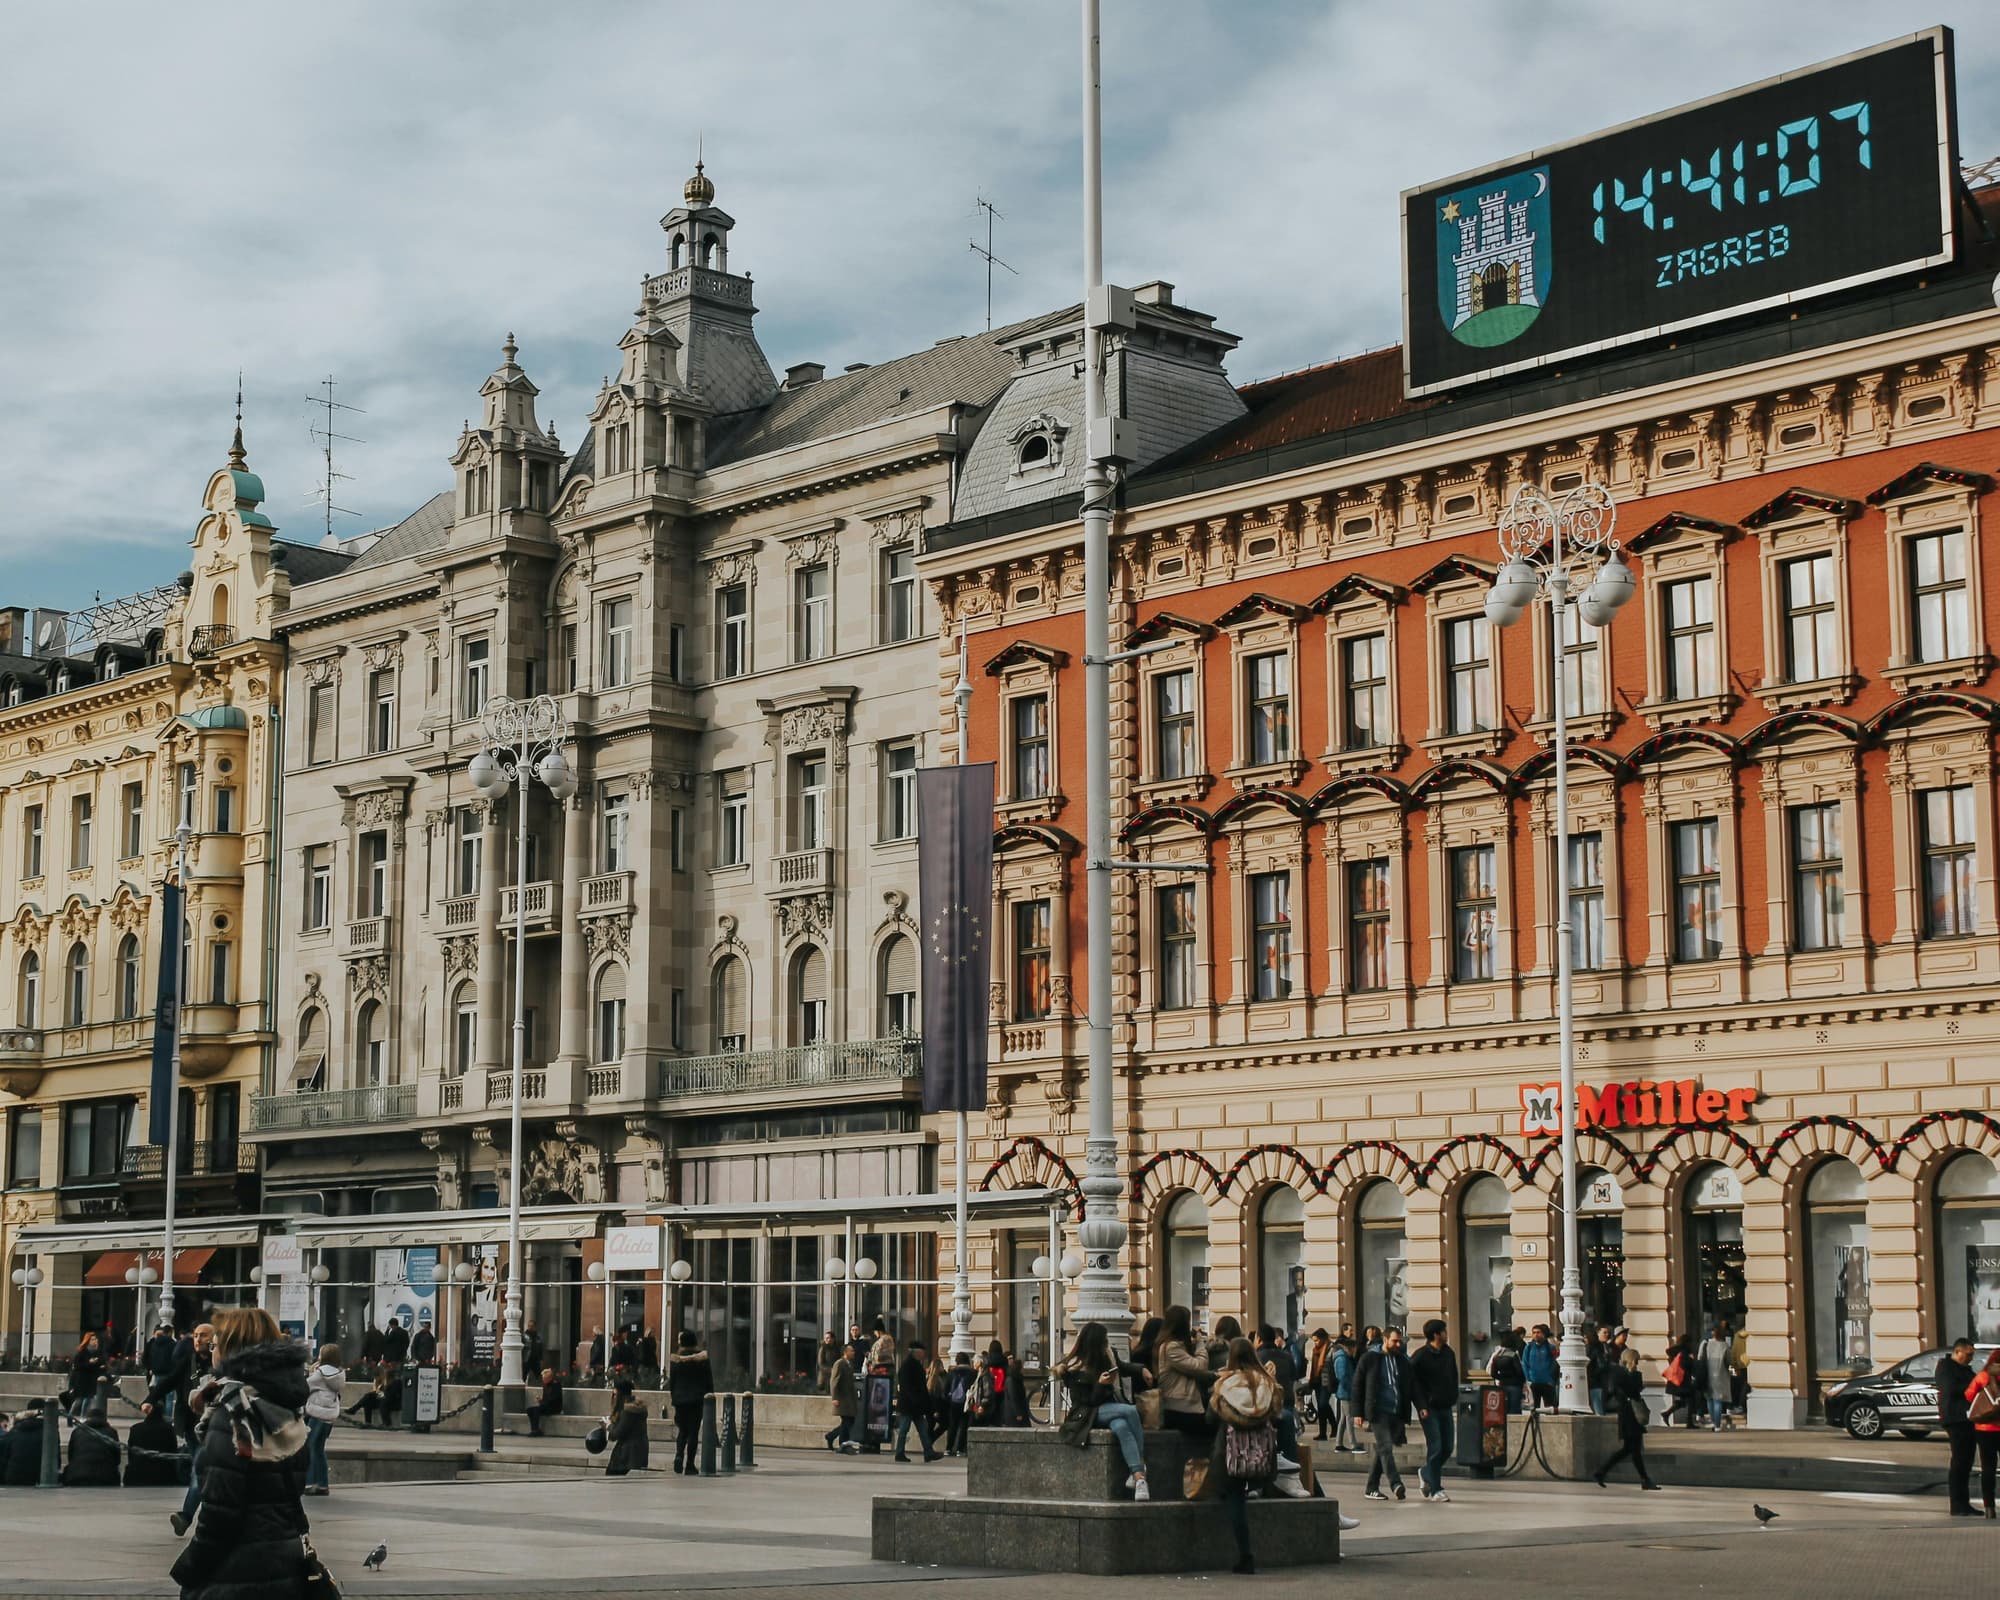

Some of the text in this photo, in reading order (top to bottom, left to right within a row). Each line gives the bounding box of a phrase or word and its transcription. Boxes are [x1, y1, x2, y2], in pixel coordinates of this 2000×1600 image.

[1592, 101, 1871, 245] 14:41:07
[1656, 224, 1790, 288] ZAGREB
[1530, 1098, 1553, 1121] M
[1574, 1079, 1758, 1130] Müller
[1597, 1188, 1608, 1198] M
[1886, 1393, 1927, 1407] KLEMM
